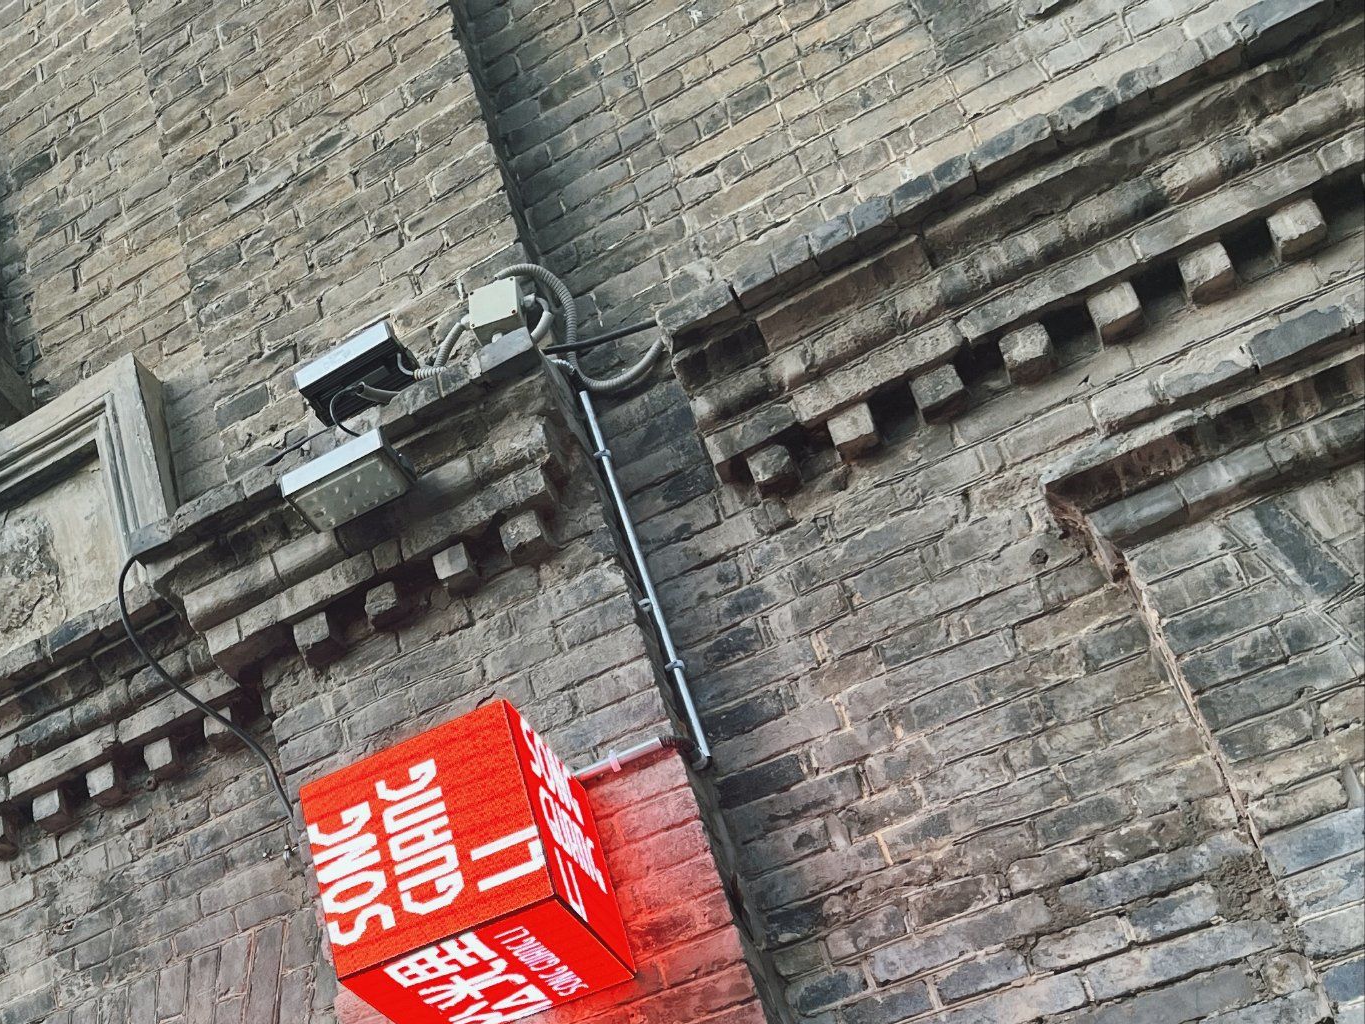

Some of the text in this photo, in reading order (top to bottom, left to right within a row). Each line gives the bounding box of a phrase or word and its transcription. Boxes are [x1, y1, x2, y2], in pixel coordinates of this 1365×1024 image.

[306, 800, 396, 947] SONG
[375, 758, 465, 915] GUANG
[471, 825, 547, 893] LI
[538, 785, 608, 895] GUANG
[554, 846, 588, 923] LI
[494, 925, 589, 997] SONG GUANG LI
